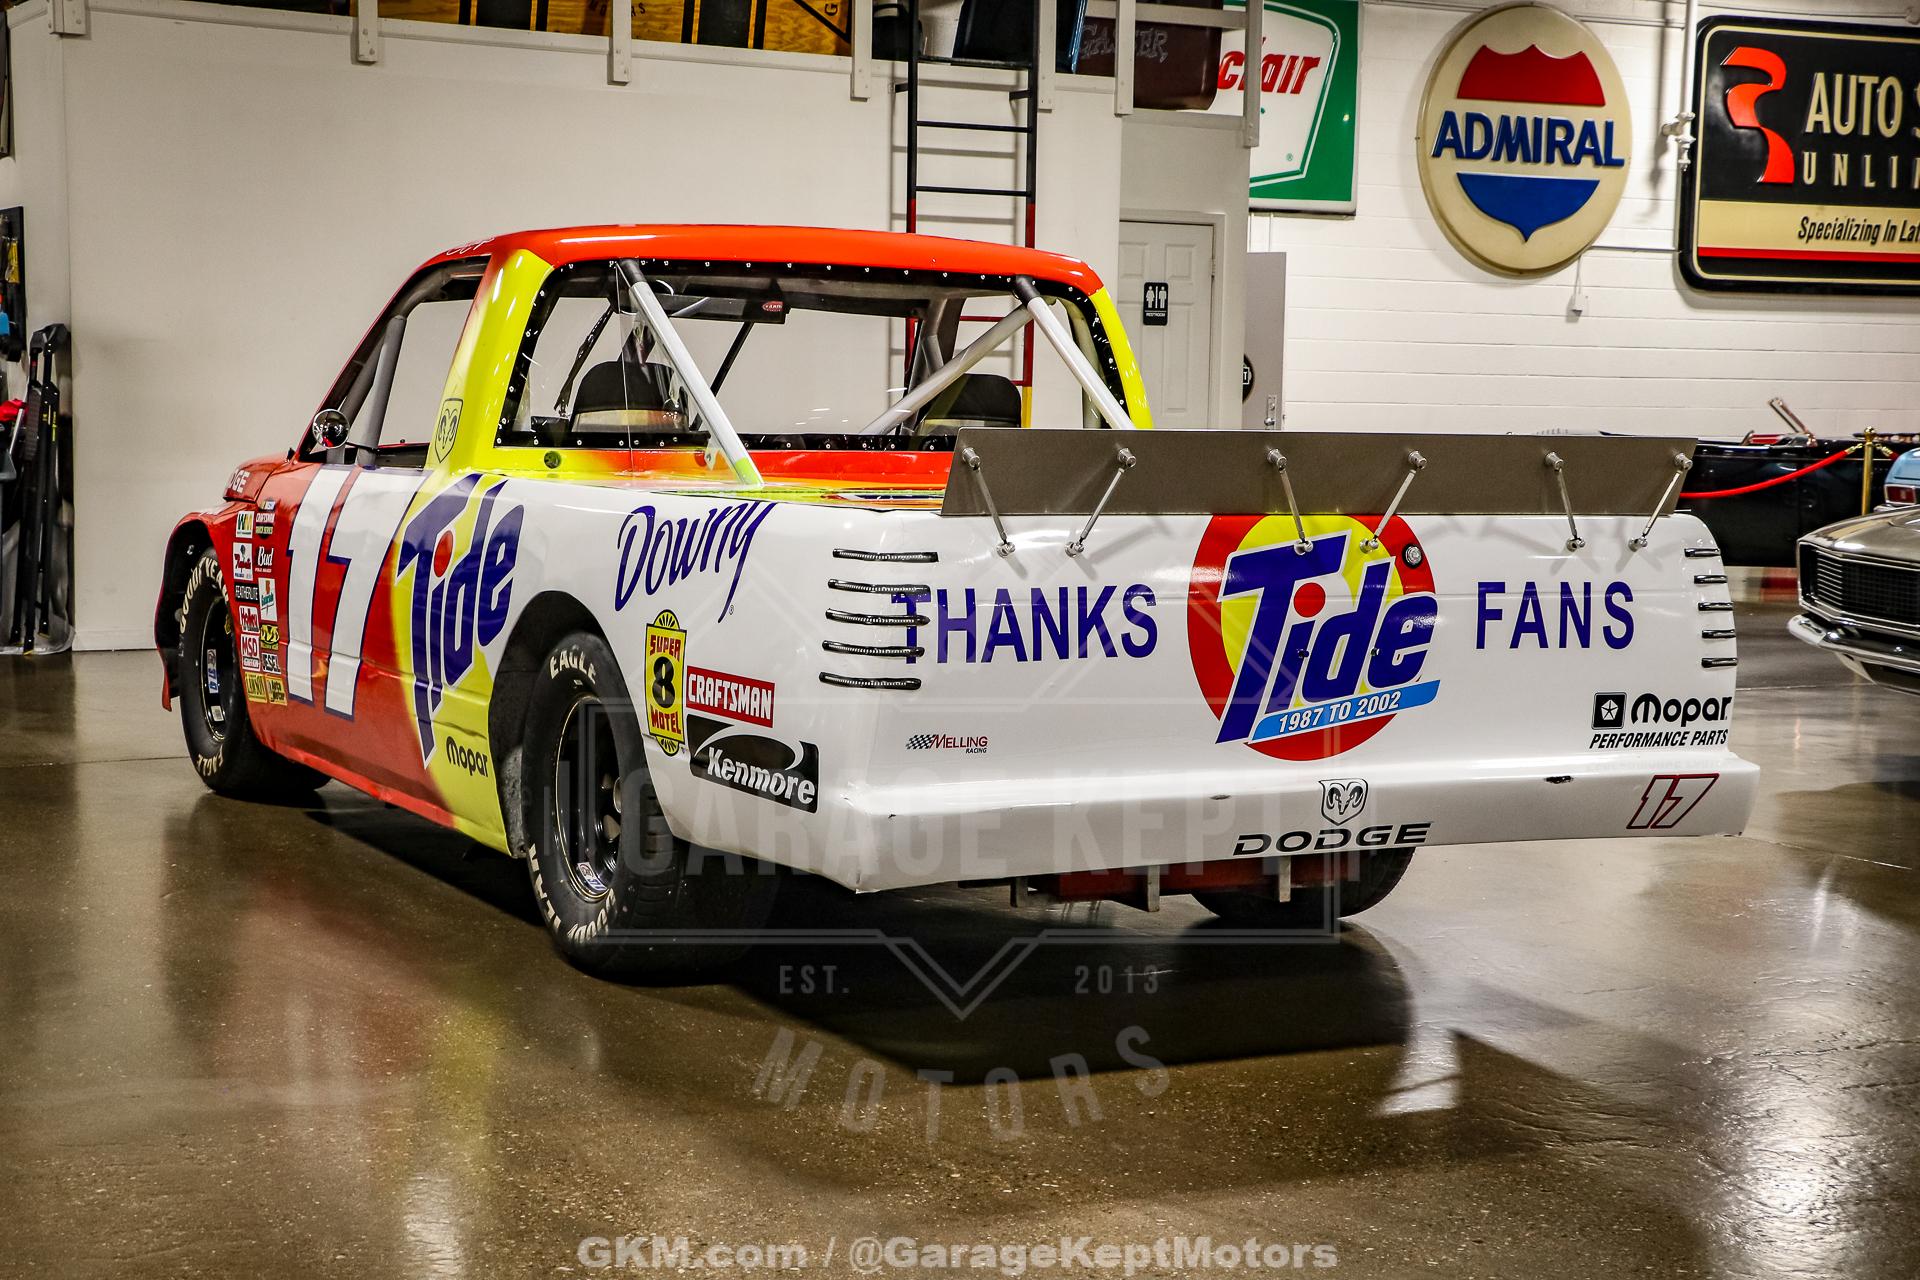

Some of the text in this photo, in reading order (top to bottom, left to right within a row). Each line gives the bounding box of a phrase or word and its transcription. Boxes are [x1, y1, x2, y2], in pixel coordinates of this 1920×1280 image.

[1805, 72, 1903, 138] AUTO
[1432, 110, 1624, 167] ADMIRAL
[1798, 215, 1880, 245] Specializing
[1883, 219, 1897, 242] In
[258, 546, 274, 567] Bud
[615, 500, 777, 623] Downy
[286, 466, 433, 722] 17
[1476, 581, 1634, 649] FANS
[396, 472, 525, 763] Tide
[891, 584, 1158, 664] THANKS
[1215, 532, 1438, 744] Tide
[242, 636, 257, 656] MSD
[549, 648, 597, 685] EAGLE
[650, 634, 681, 661] SUPER
[652, 656, 675, 708] 8
[688, 674, 772, 720] CRAFTSMAN
[651, 711, 681, 735] MOTEL
[1279, 691, 1401, 733] 1987 TO 2002
[1631, 692, 1732, 727] Mopar
[446, 735, 488, 778] Mopar
[929, 734, 988, 750] MELLING
[1589, 729, 1728, 749] PERFORMANCE PARTS
[707, 747, 815, 804] Kenmore
[1626, 773, 1720, 829] 17
[1233, 823, 1433, 856] DODGE
